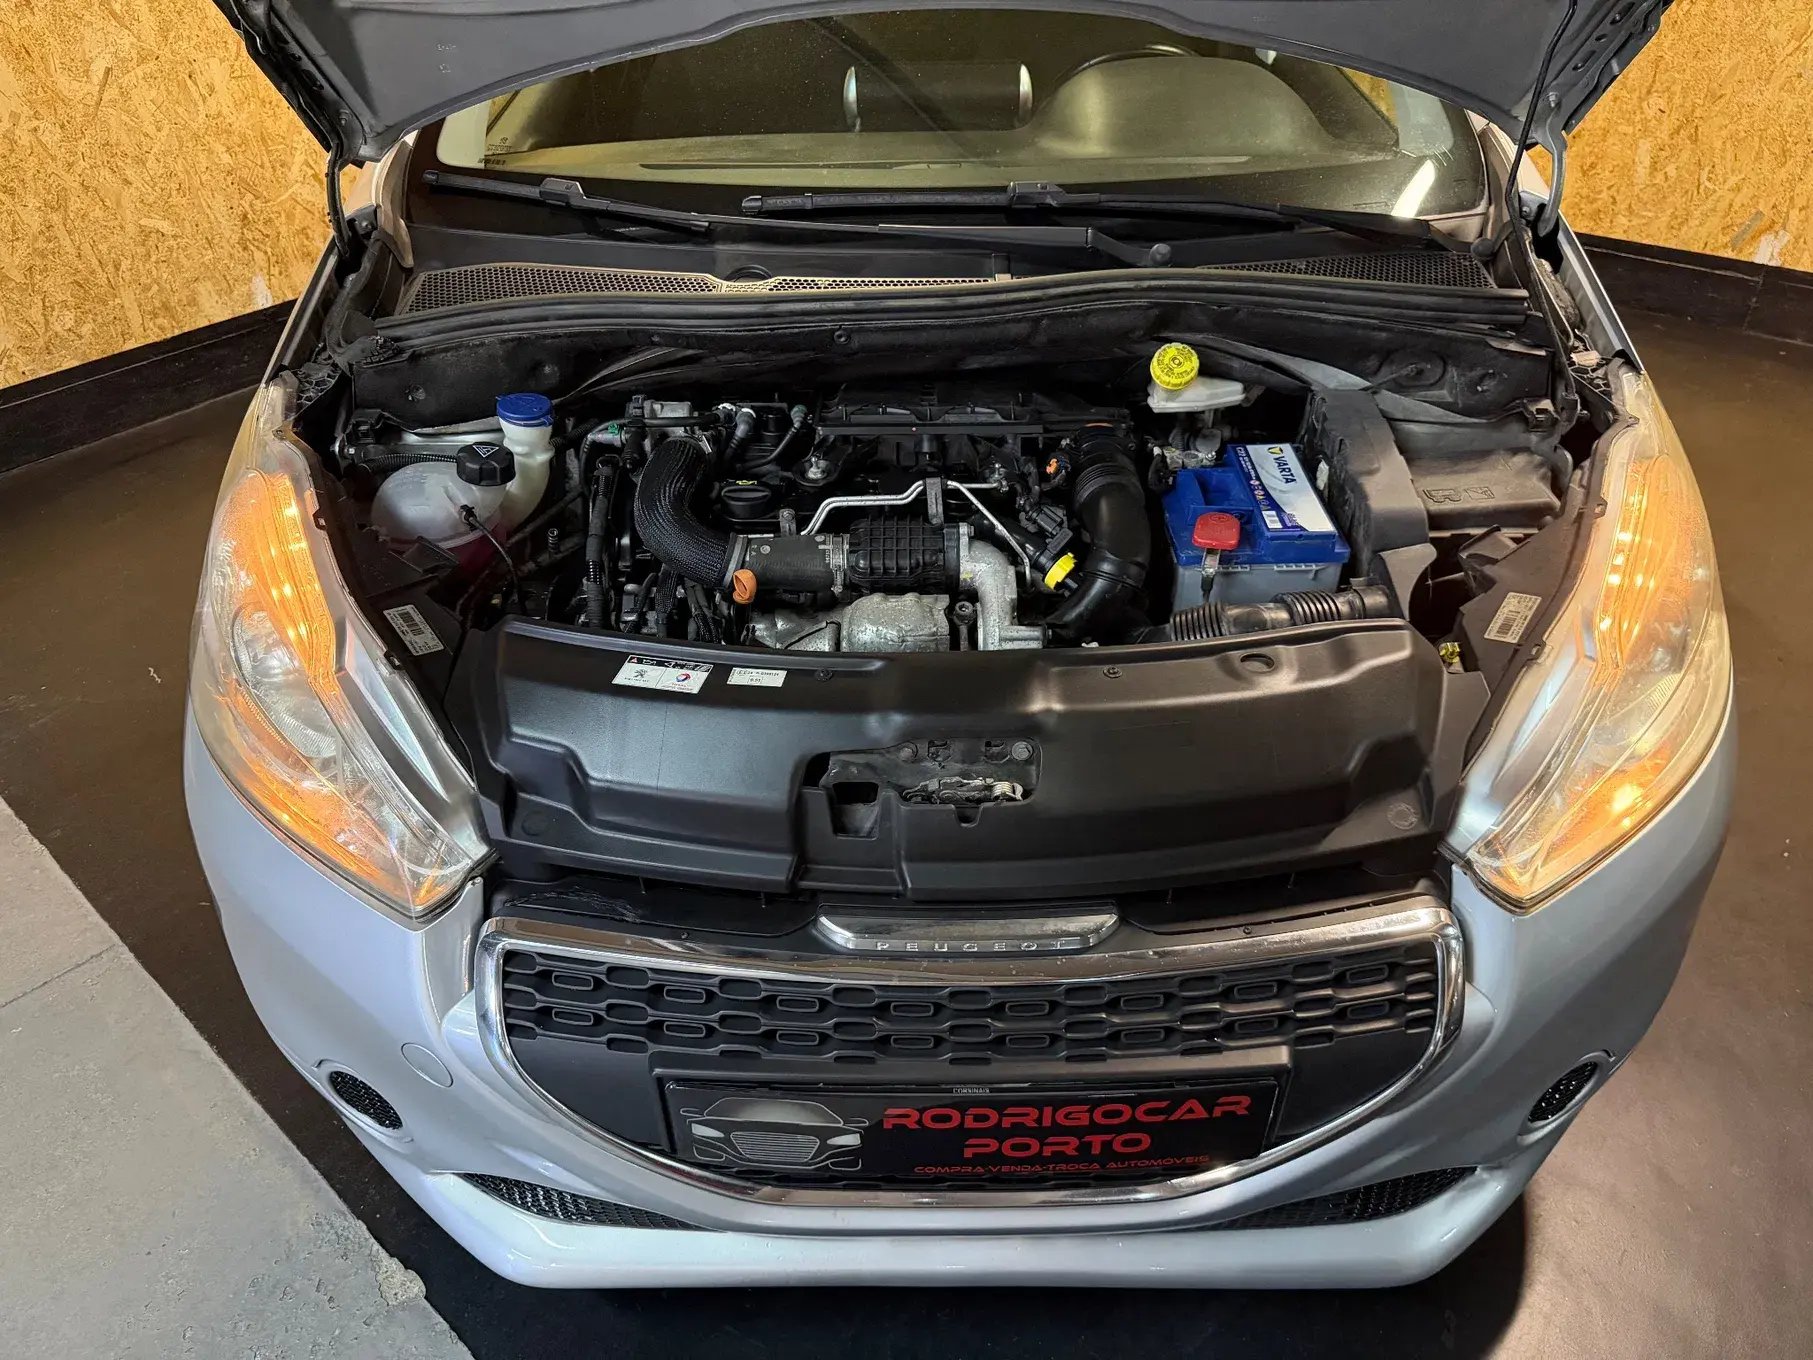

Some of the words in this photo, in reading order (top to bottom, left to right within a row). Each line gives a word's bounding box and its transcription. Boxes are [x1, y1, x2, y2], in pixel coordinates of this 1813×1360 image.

[1273, 456, 1296, 484] VARTA
[875, 940, 1066, 951] PEUGEOT
[883, 1096, 1251, 1129] RODRIGOCAR
[963, 1133, 1151, 1158] PORTO
